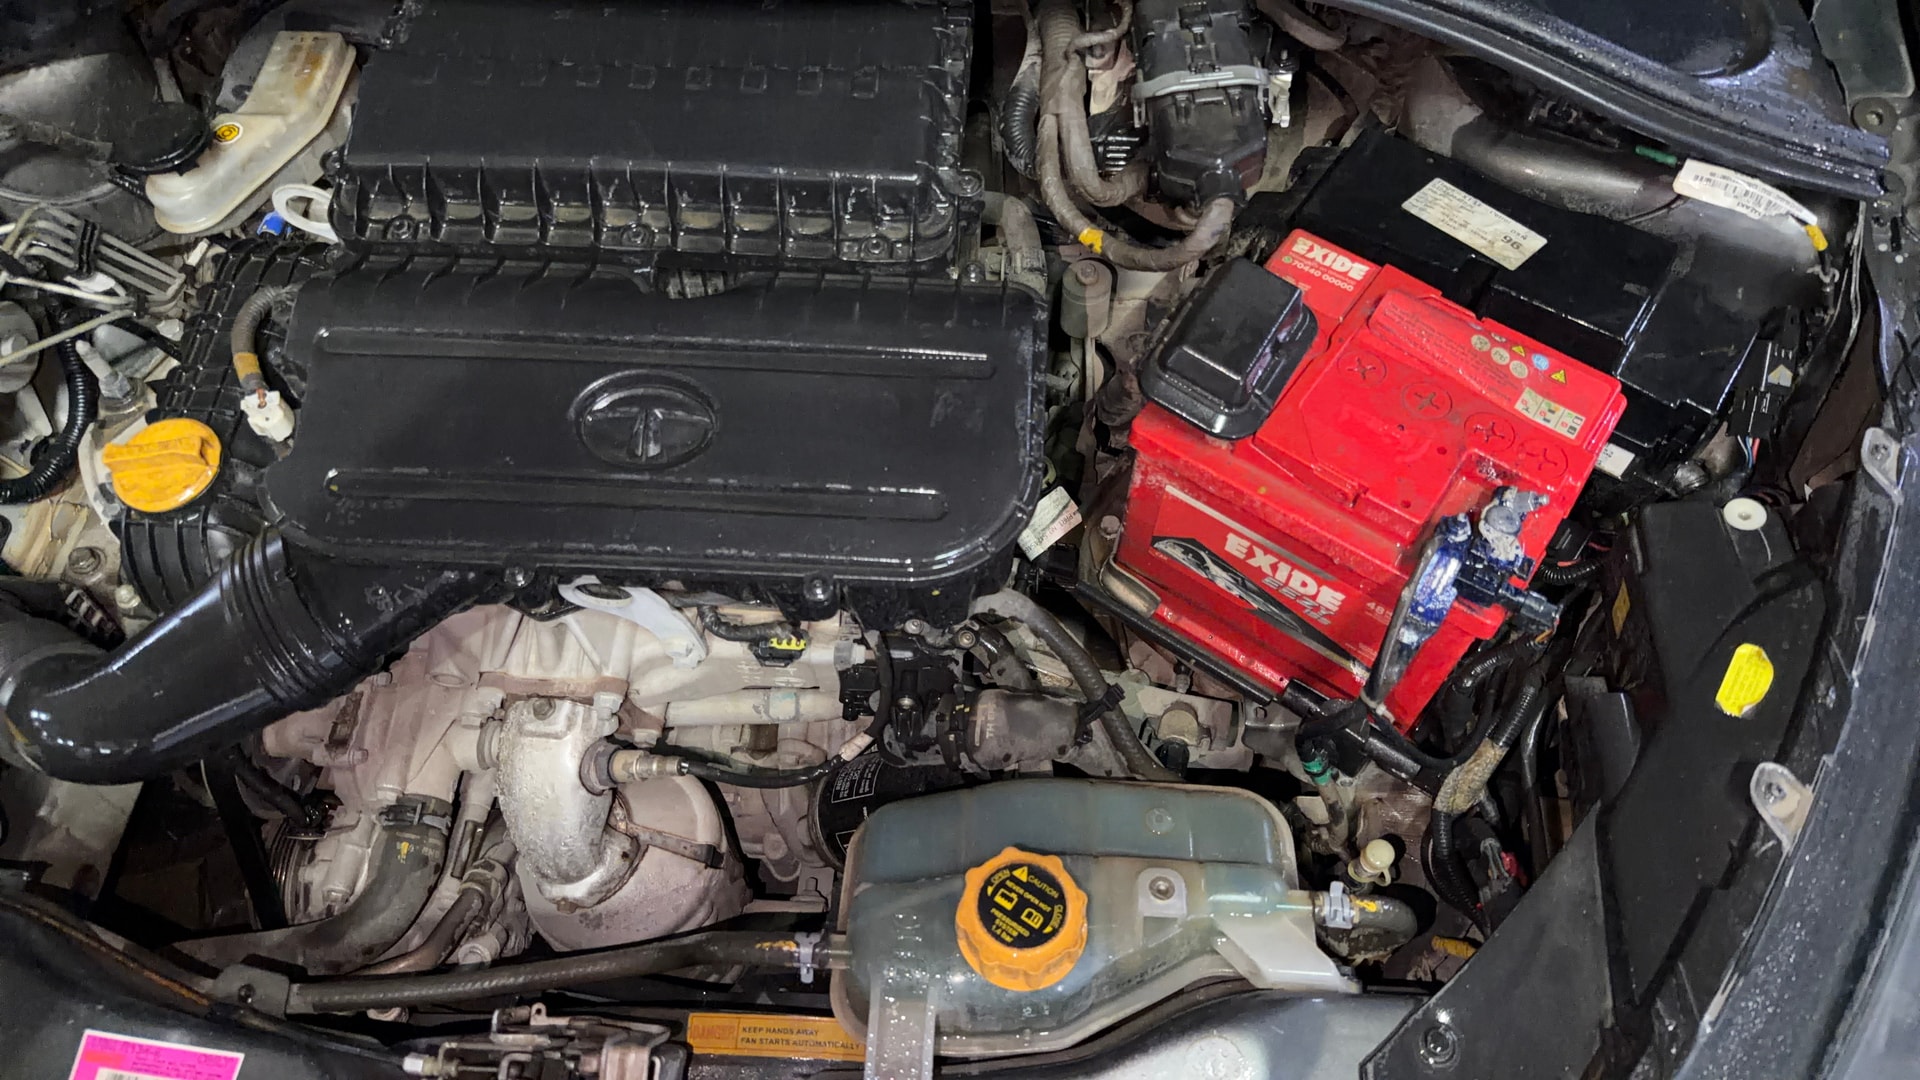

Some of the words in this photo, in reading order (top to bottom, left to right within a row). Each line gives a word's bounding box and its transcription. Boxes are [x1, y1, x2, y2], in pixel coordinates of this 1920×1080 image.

[1501, 235, 1523, 250] 96
[1291, 237, 1370, 281] EXIDE
[1292, 260, 1322, 277] 70440
[1321, 273, 1354, 292] 00000
[1224, 532, 1346, 612] EXIDE
[1262, 577, 1337, 617] EEZY
[990, 868, 1011, 884] OPEN
[1028, 875, 1059, 899] CAUTION
[1005, 880, 1025, 895] NEVER
[1023, 891, 1040, 905] OPEN
[1038, 900, 1052, 912] HOT
[740, 1037, 757, 1045] FAN
[759, 1038, 791, 1046] STARTS
[792, 1039, 861, 1050] AUTOMATICALLY
[742, 1026, 764, 1034] KEEP
[765, 1027, 794, 1035] HANDS
[794, 1028, 819, 1037] AWAY
